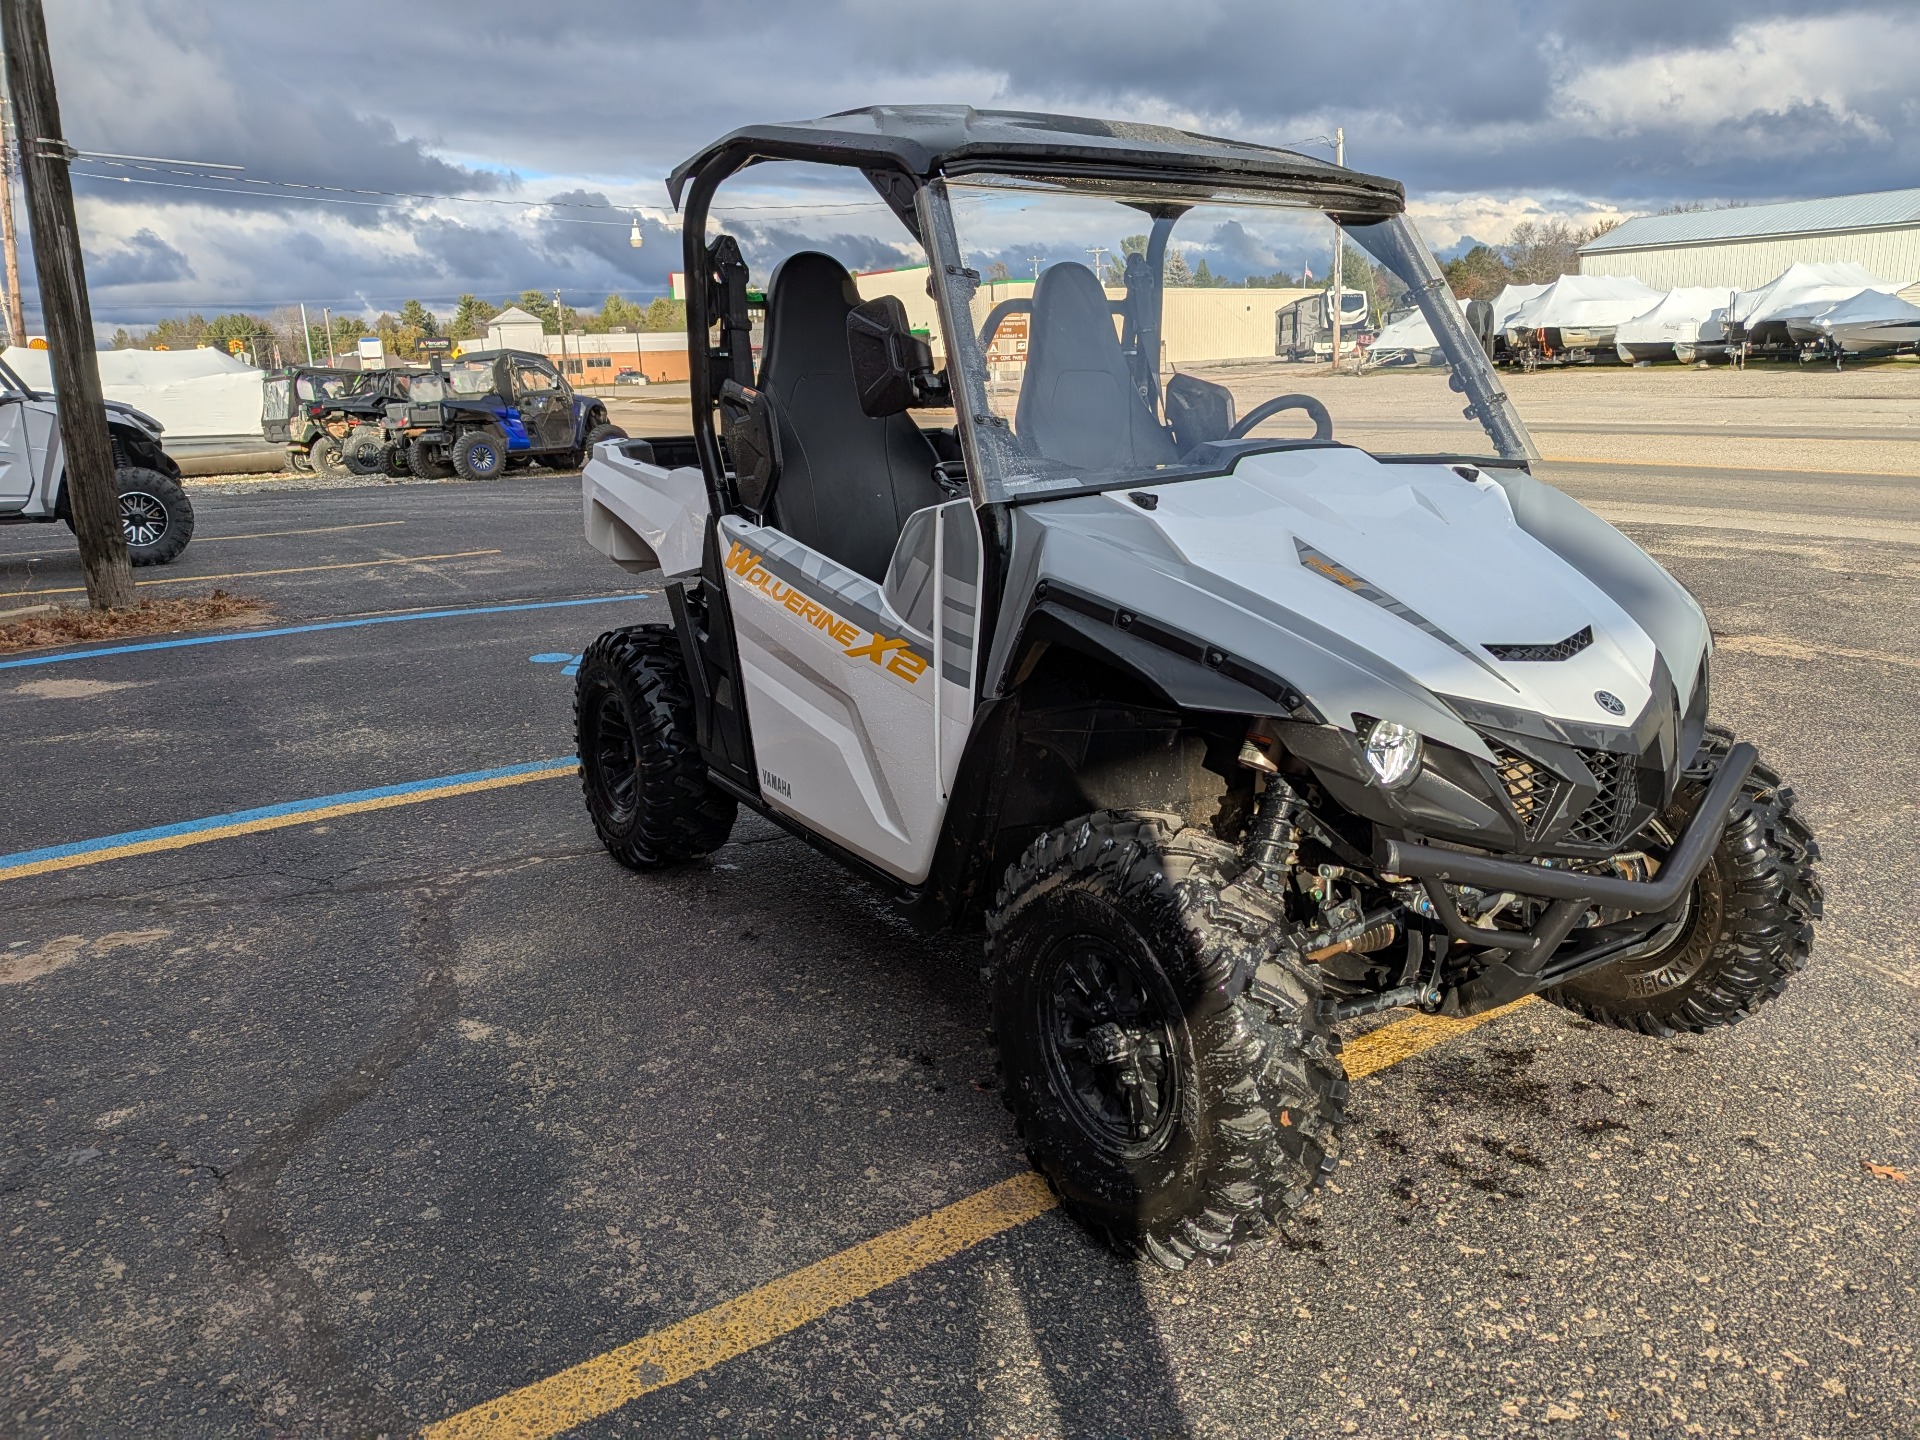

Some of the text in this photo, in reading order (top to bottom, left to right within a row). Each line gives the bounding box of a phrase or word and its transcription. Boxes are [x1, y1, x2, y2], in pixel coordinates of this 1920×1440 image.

[725, 539, 928, 685] WOLVERINE X2
[762, 768, 791, 799] YAMAHA
